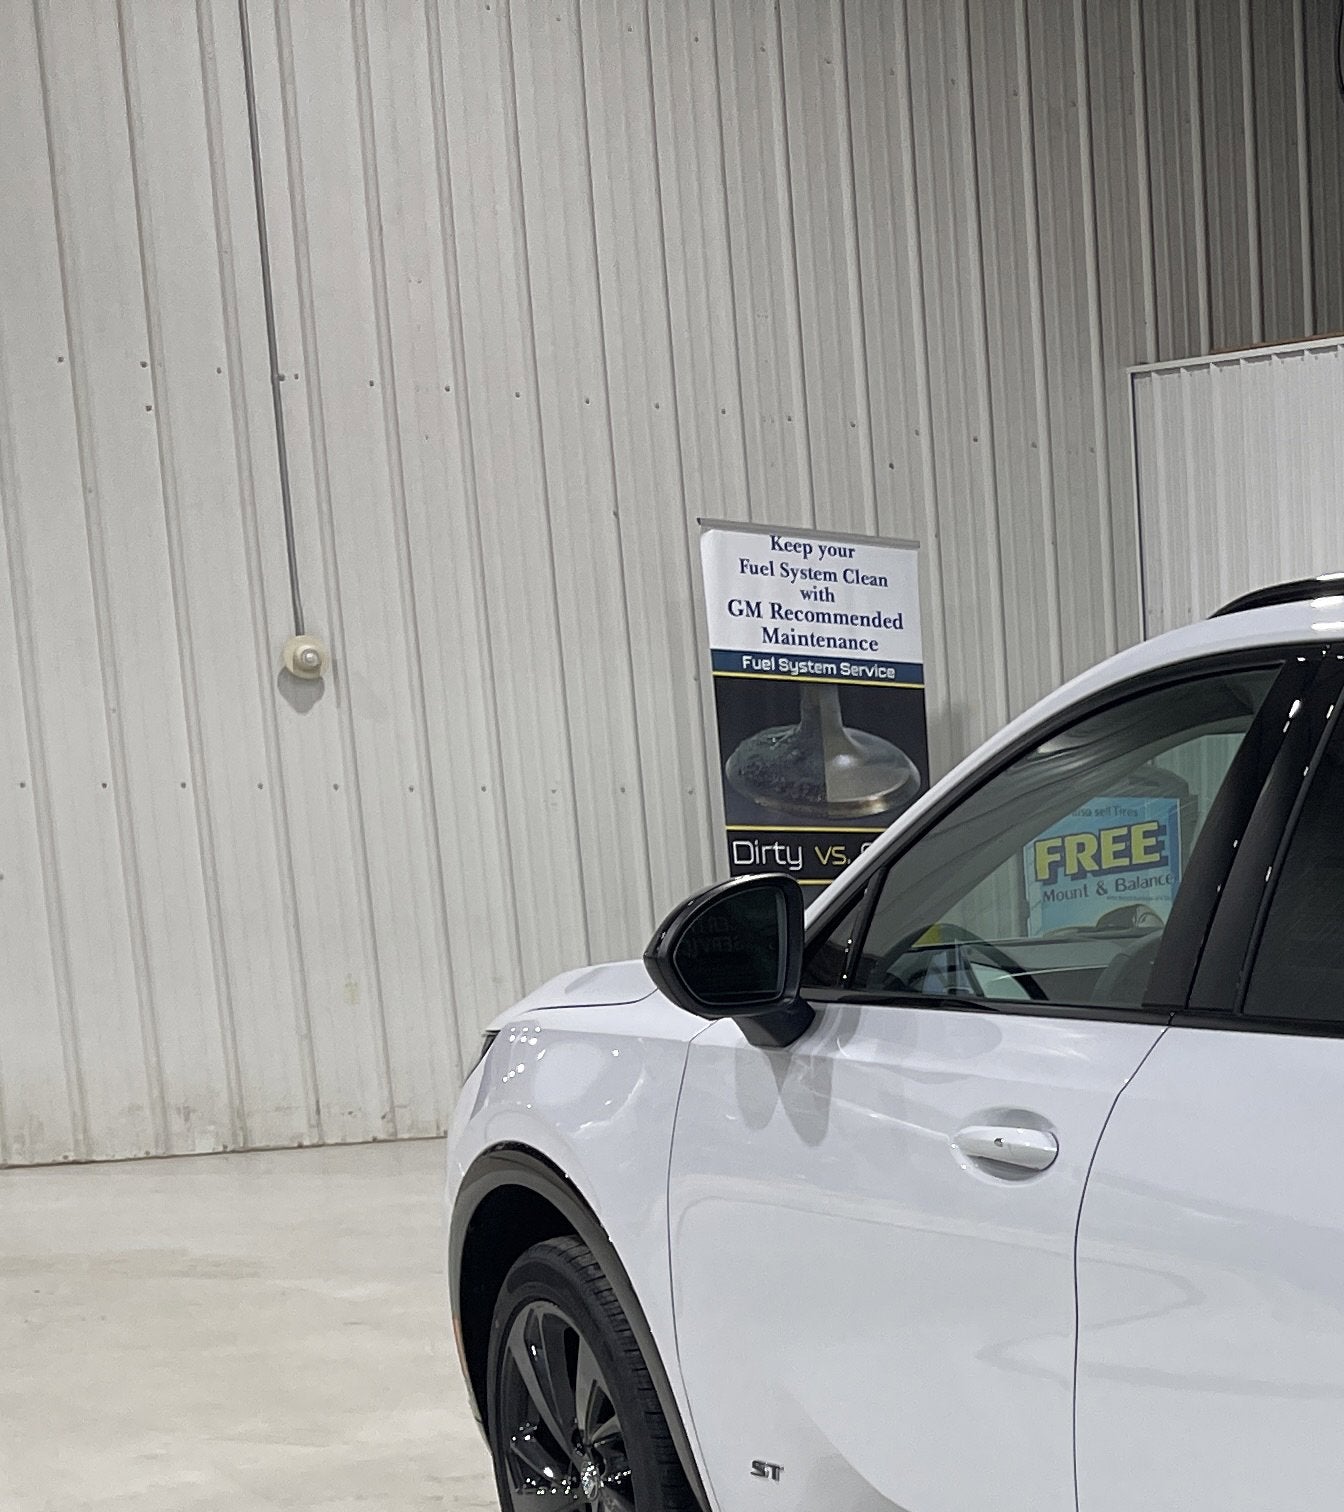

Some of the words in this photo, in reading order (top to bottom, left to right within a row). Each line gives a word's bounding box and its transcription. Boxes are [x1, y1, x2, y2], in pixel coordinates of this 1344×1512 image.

[769, 533, 813, 560] Keep
[818, 543, 857, 561] your
[739, 557, 775, 577] Fuel
[779, 561, 839, 584] System
[842, 567, 889, 588] Clean
[799, 585, 836, 603] with
[727, 598, 763, 620] GM
[770, 602, 904, 631] Recommended
[761, 626, 880, 652] Maintenance
[741, 655, 775, 671] Fuel
[779, 658, 838, 677] System
[840, 662, 896, 680] Service
[732, 839, 803, 869] Dirty
[814, 846, 851, 867] vs.
[1034, 820, 1166, 885] FREE
[1042, 884, 1089, 903] Mount
[1096, 879, 1108, 896] &
[1115, 873, 1174, 893] Balance
[750, 1459, 784, 1483] ST
